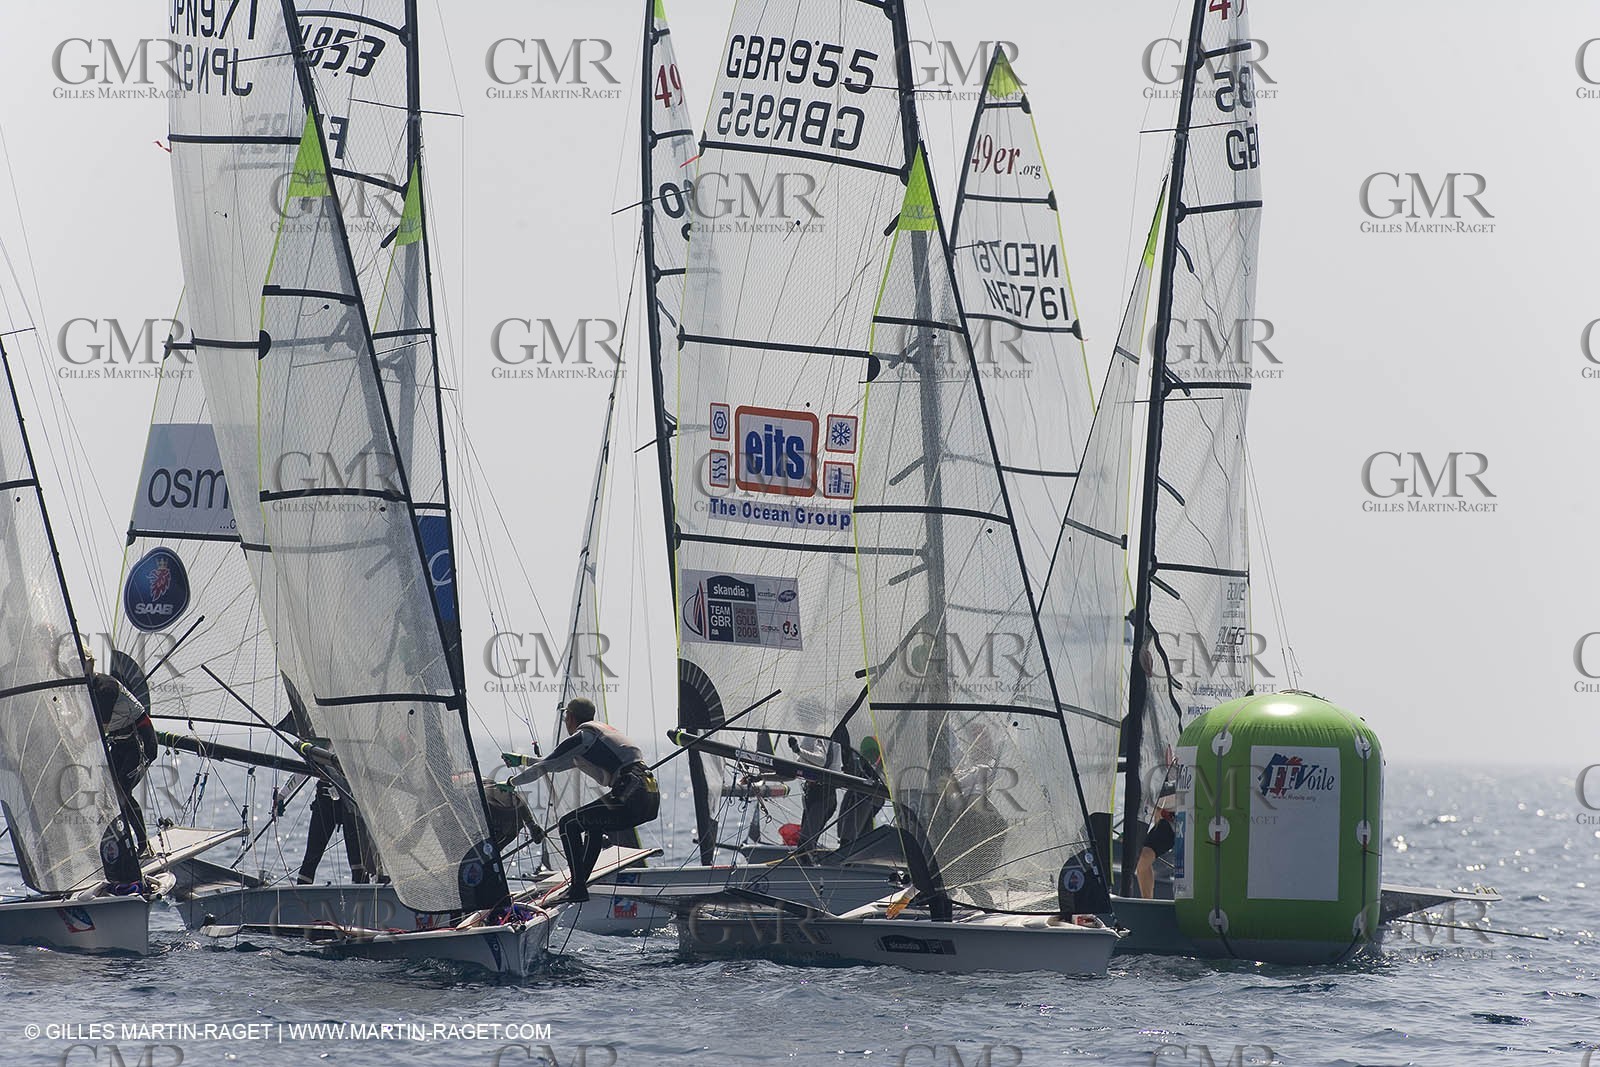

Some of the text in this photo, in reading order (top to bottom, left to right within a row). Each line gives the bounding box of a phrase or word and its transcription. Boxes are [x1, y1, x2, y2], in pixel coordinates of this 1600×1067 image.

[726, 34, 879, 94] GBR955
[1226, 124, 1260, 171] GB
[983, 278, 1069, 321] NED761
[745, 424, 805, 480] eits
[710, 498, 852, 530] The Ocean Group
[135, 603, 174, 615] SAAB
[710, 605, 730, 615] TEAM
[711, 615, 731, 627] GBR
